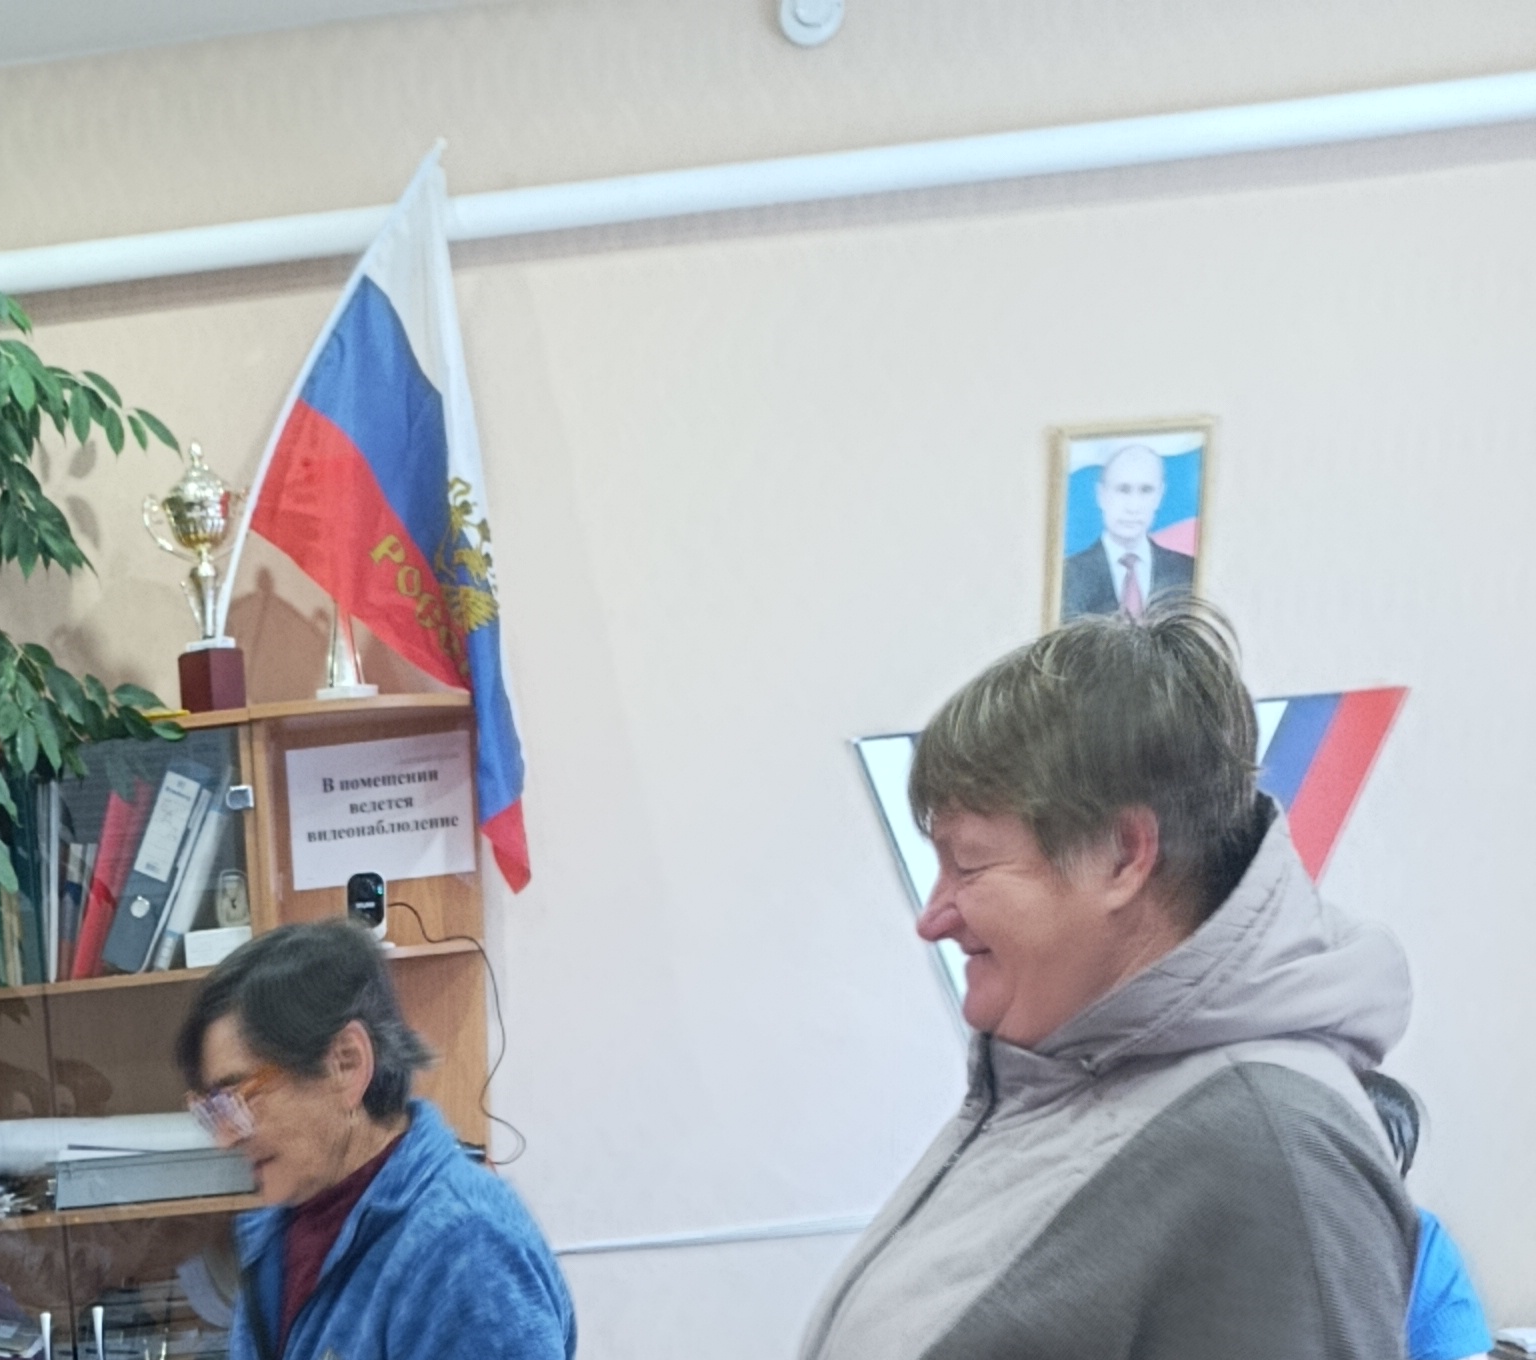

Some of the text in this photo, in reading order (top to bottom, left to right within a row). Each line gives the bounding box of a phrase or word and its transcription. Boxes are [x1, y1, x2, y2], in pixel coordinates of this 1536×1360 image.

[322, 769, 438, 793] В помещении
[349, 796, 414, 814] ведется
[307, 815, 459, 843] видеонаблюдение
